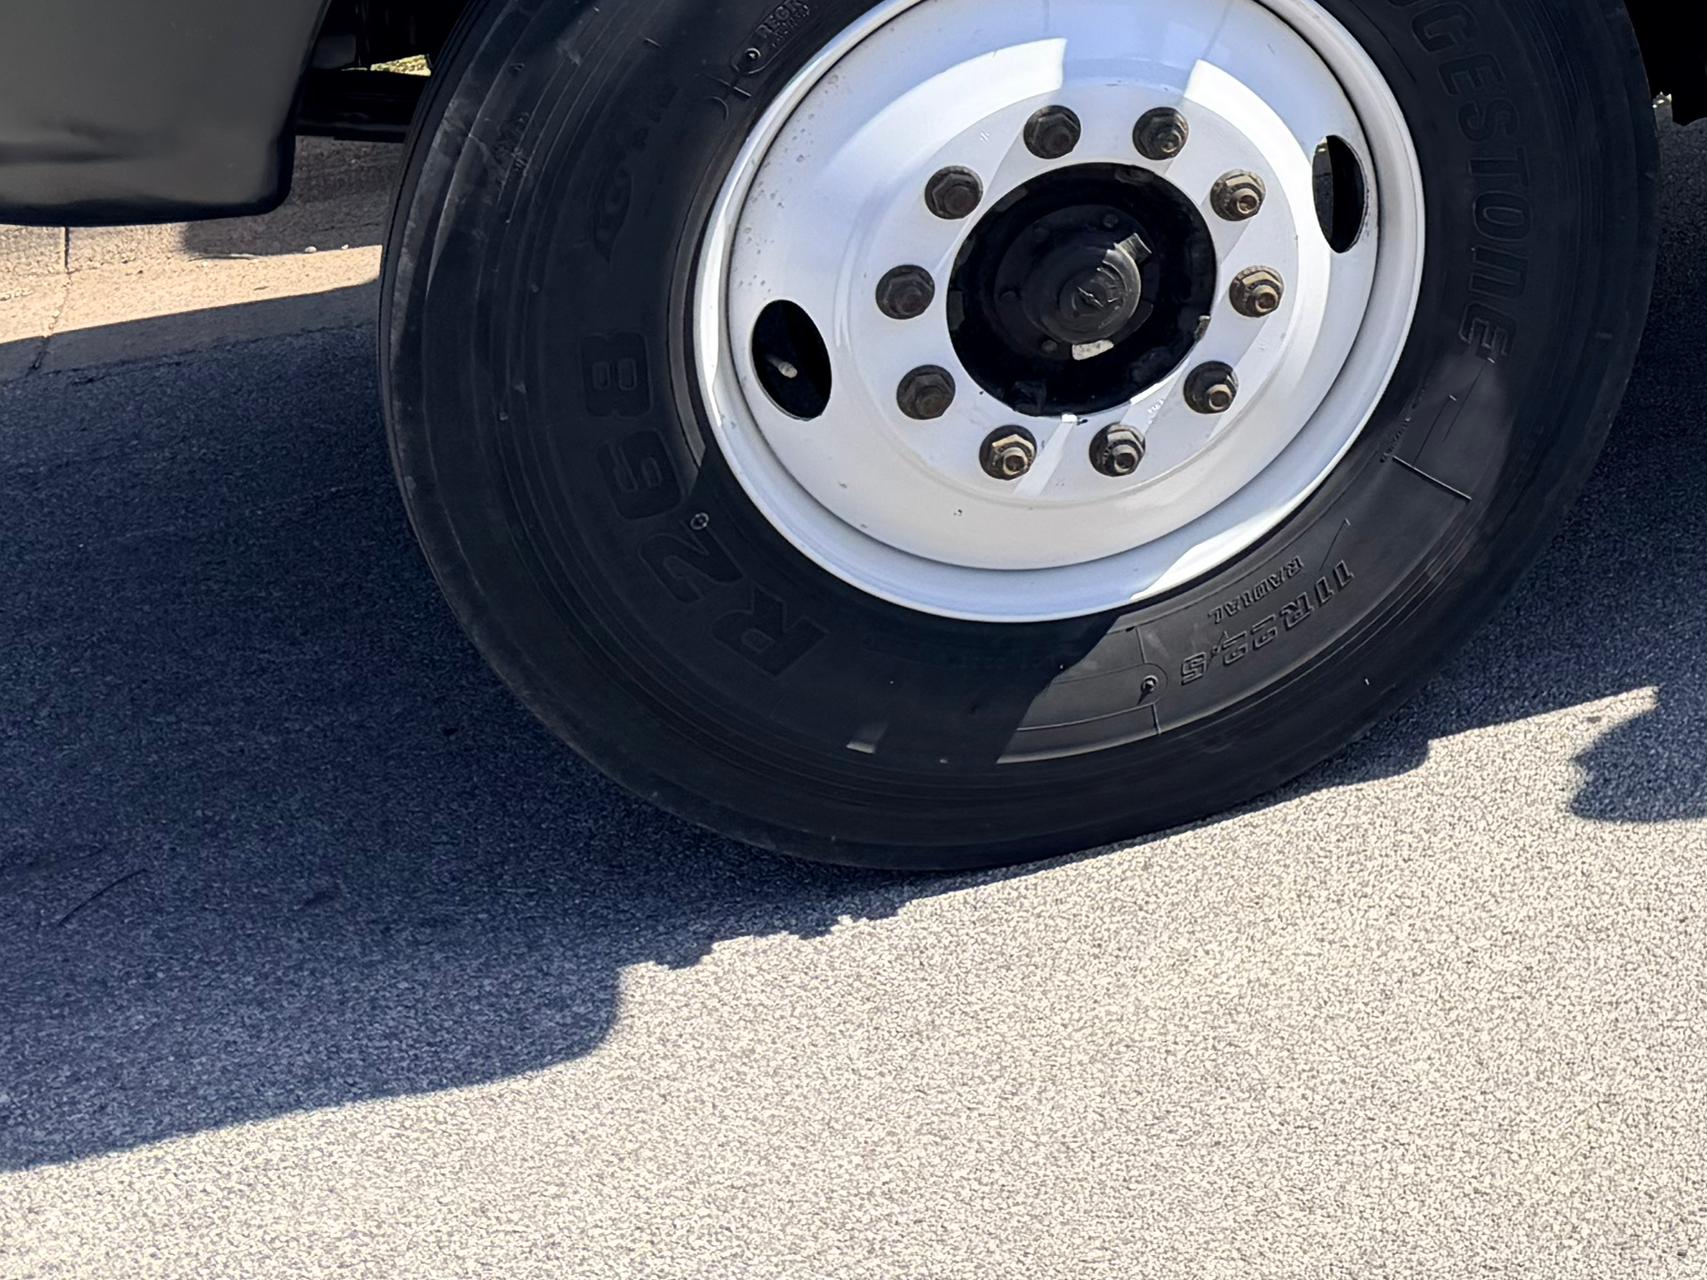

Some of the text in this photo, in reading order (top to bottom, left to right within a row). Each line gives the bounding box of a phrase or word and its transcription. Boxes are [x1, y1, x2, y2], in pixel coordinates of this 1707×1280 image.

[580, 329, 828, 678] R268
[1180, 558, 1356, 687] 11R22.5
[1209, 554, 1306, 624] RADIAL
